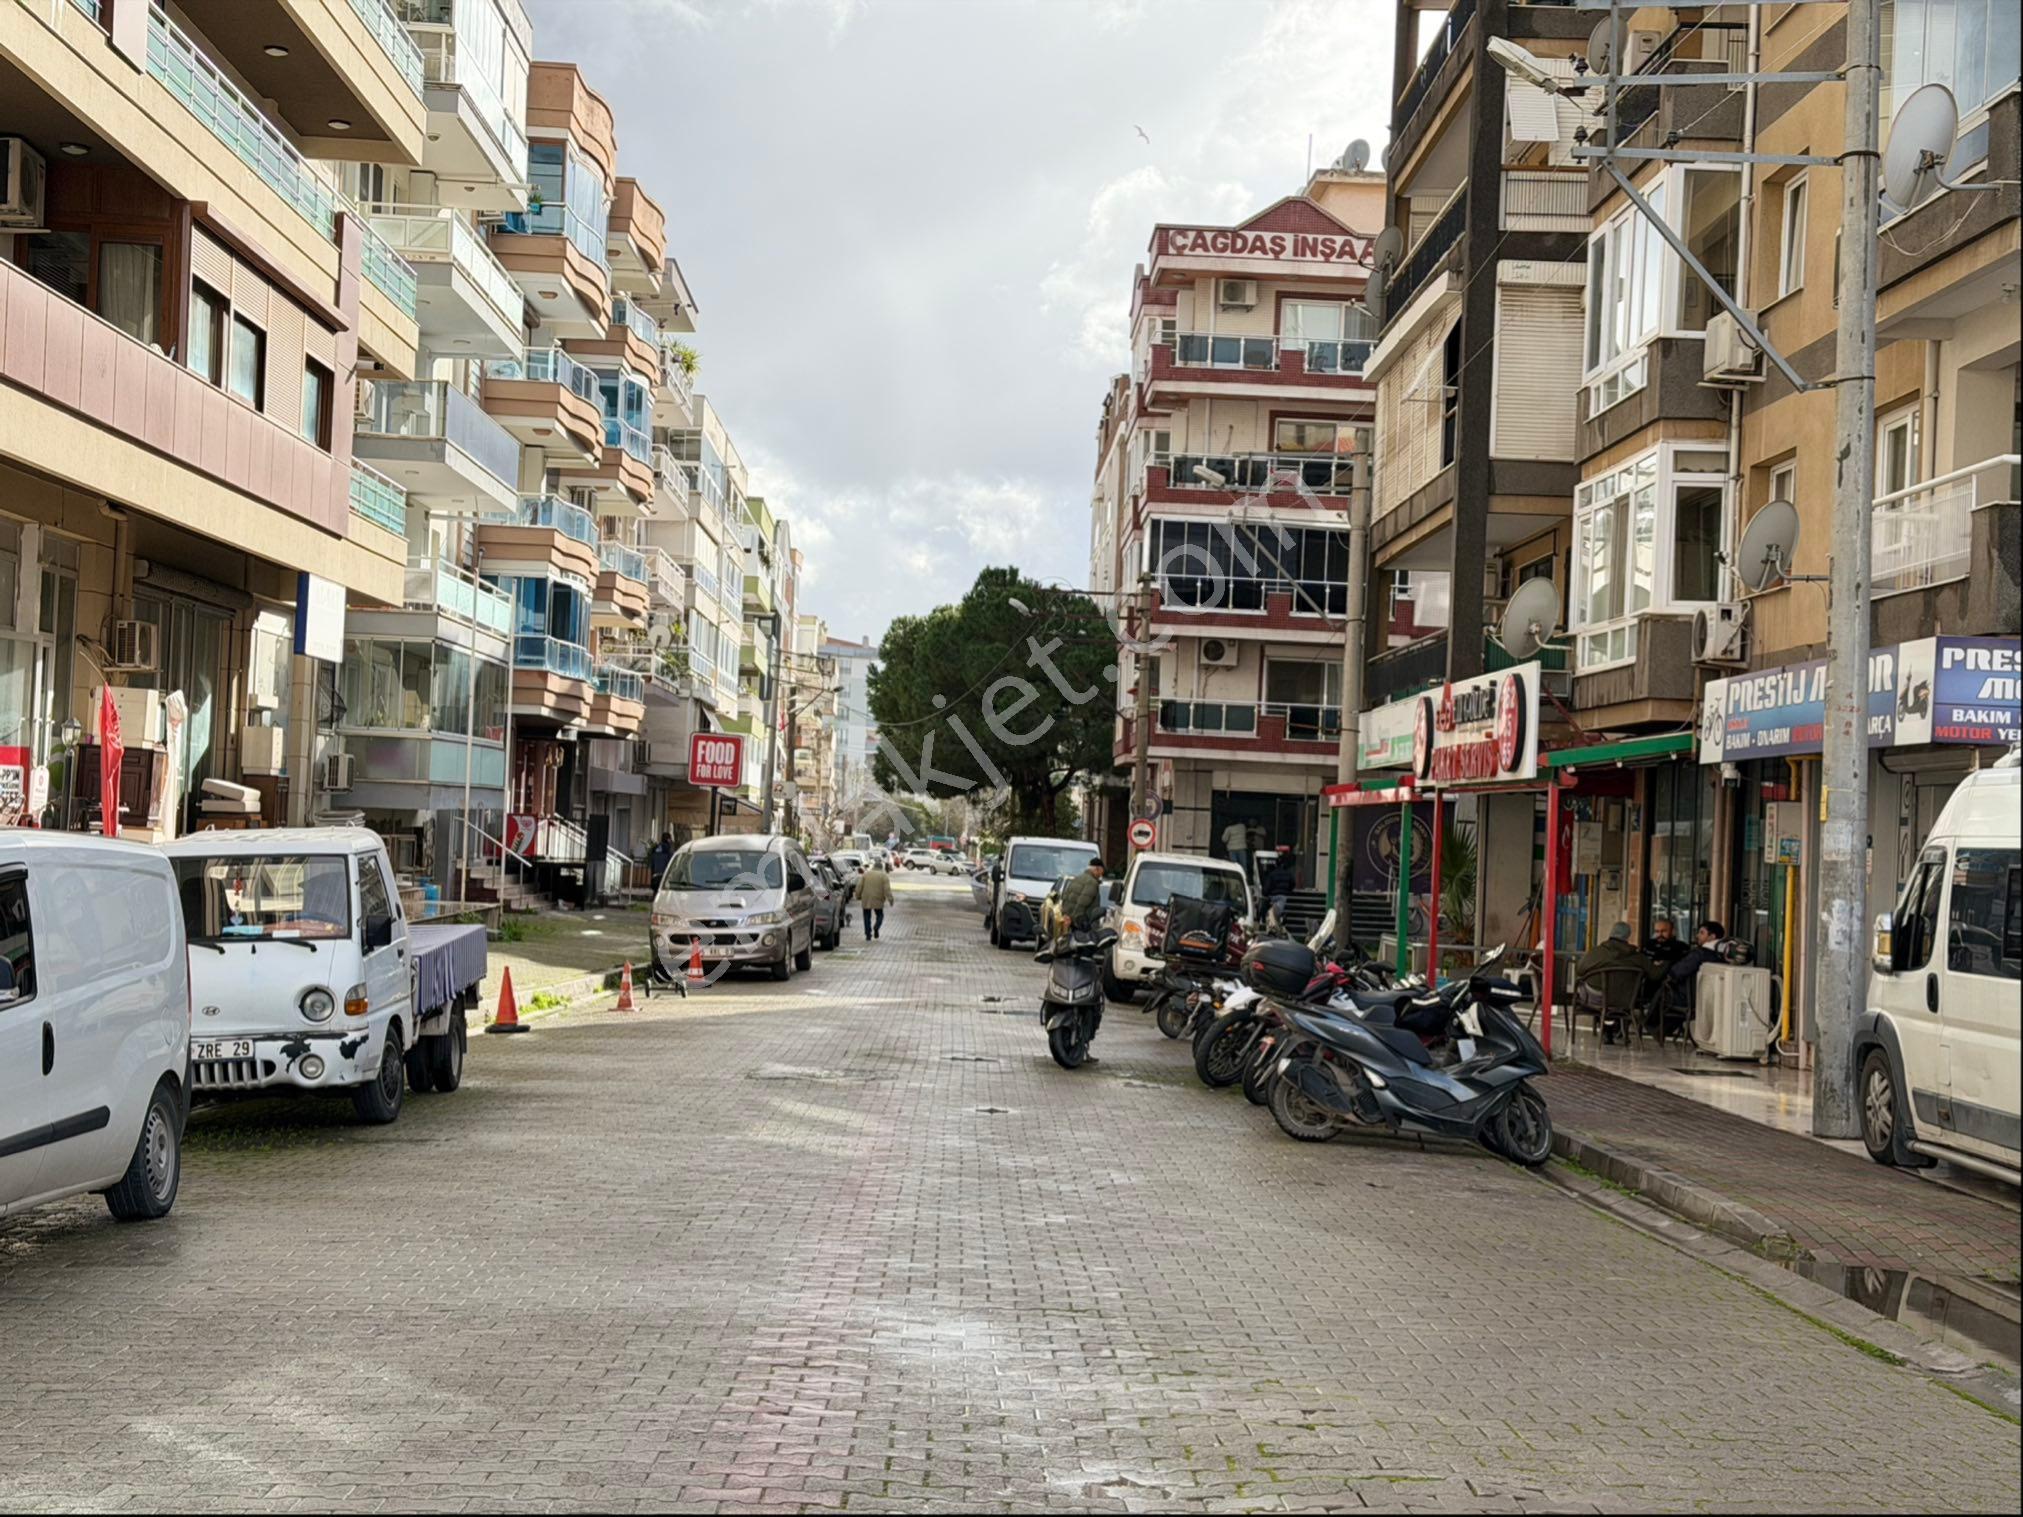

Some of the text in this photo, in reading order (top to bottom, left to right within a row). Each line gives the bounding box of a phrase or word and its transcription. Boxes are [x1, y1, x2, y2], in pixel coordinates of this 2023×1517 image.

[1293, 233, 1374, 263] İNŞAA
[1952, 708, 2011, 724] BAKIM
[1867, 714, 1892, 740] RÇA
[1935, 726, 2021, 741] MOTOR YE
[697, 740, 736, 765] FOOD
[696, 764, 733, 780] FOR LOVE
[197, 1041, 250, 1059] ZRE 29
